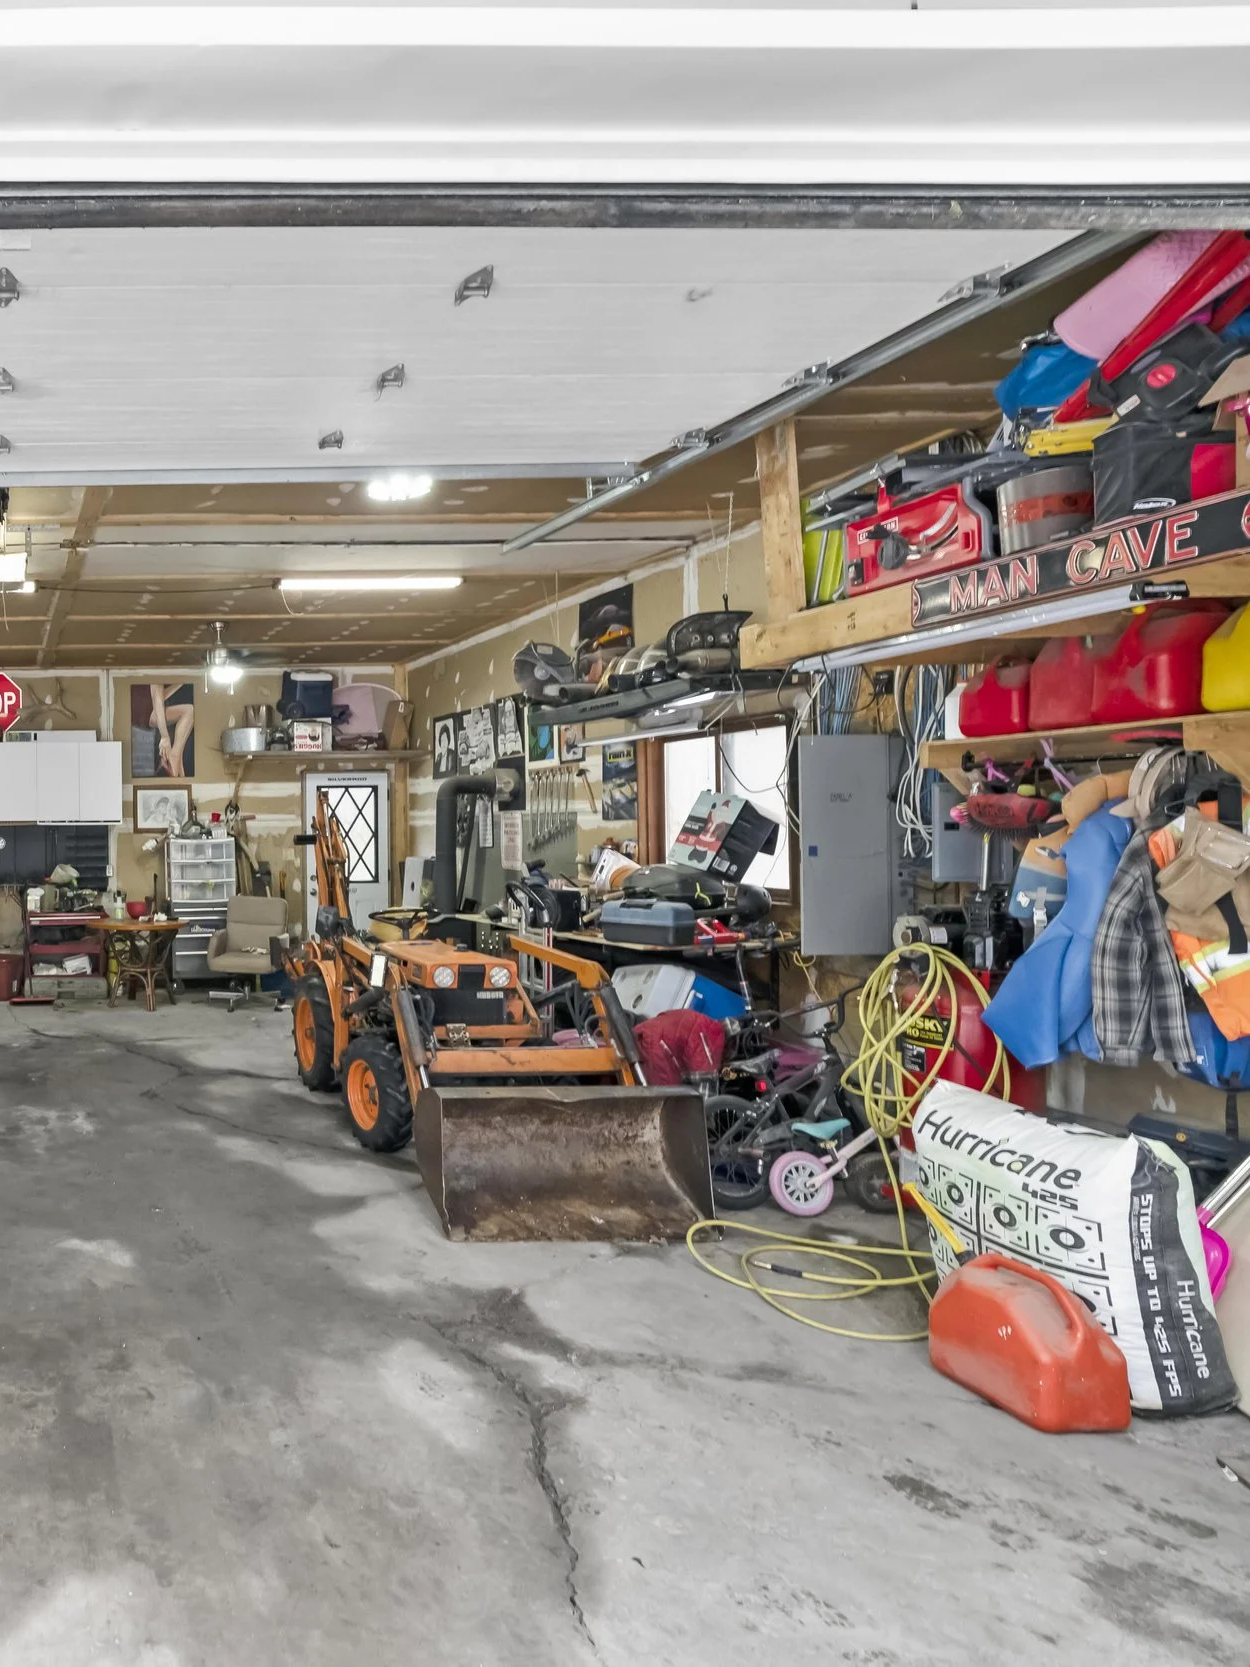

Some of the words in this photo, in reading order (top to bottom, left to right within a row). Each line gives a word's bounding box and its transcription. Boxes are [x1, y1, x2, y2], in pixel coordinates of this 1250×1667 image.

[950, 554, 1038, 613] MAN
[1066, 510, 1199, 585] CAVE
[918, 1110, 1082, 1190] Hurricane
[1021, 1182, 1078, 1211] 425
[1139, 1193, 1153, 1250] STOPS
[1142, 1255, 1158, 1281] UP
[1147, 1285, 1161, 1311] TO
[1153, 1316, 1171, 1353] 425
[1176, 1280, 1210, 1379] Hurricane
[1162, 1359, 1183, 1397] FPS
